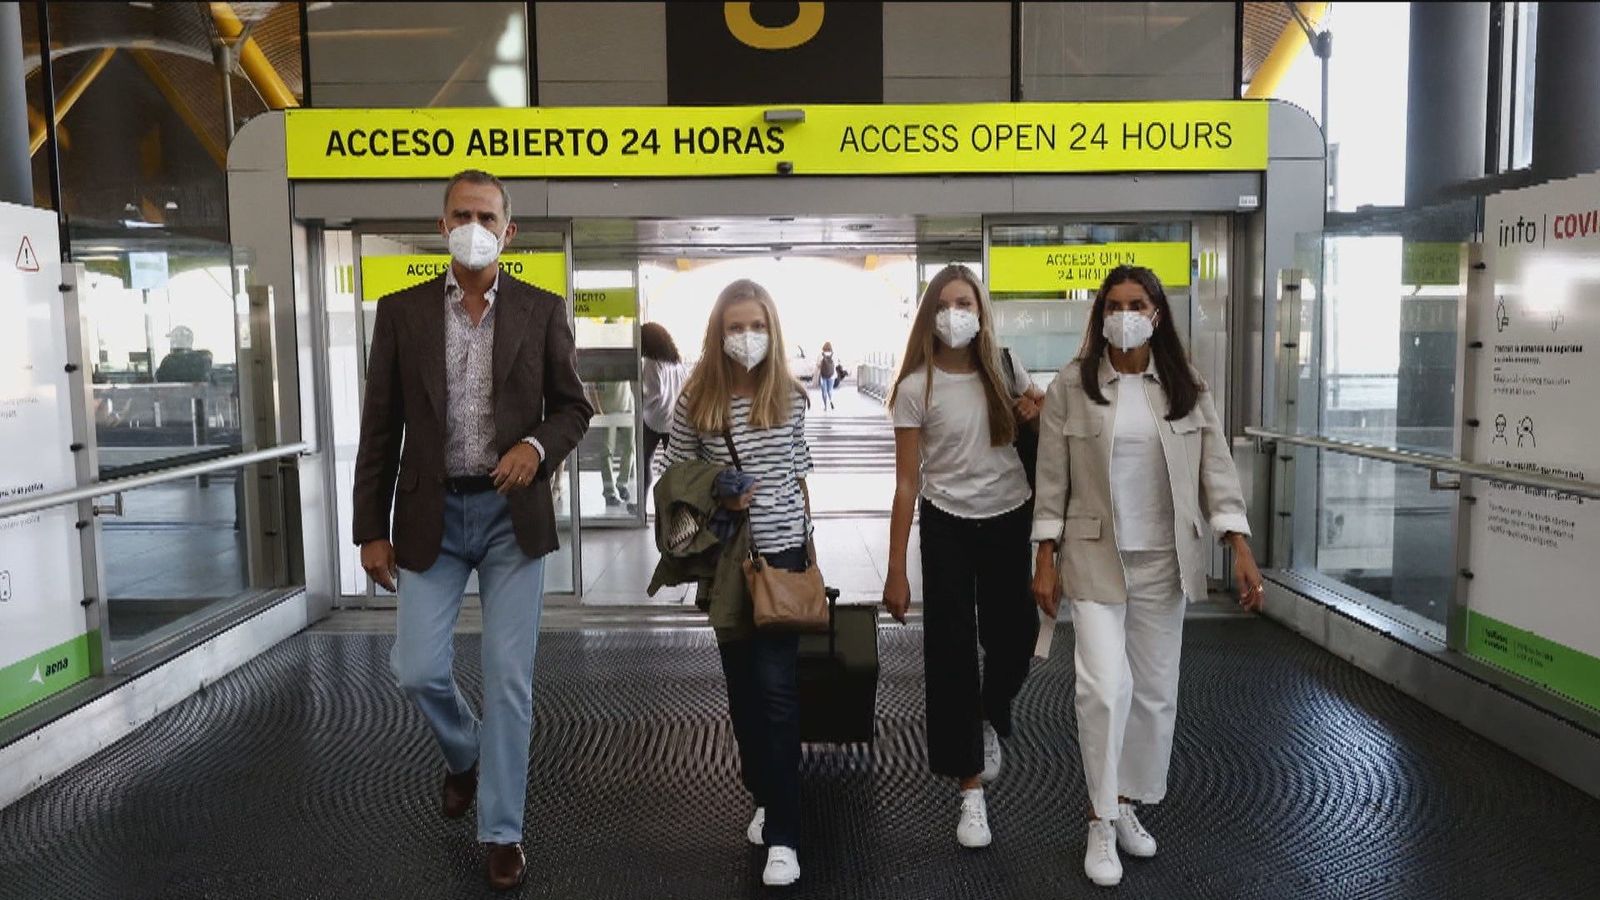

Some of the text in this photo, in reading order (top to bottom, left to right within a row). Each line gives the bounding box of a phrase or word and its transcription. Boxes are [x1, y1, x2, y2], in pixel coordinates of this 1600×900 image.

[326, 126, 784, 157] ACCESO ABIERTO 24 HORAS
[840, 121, 1232, 153] ACCESS OPEN 24 HOURS
[1499, 216, 1536, 247] info
[1554, 210, 1600, 240] COVI
[406, 262, 450, 276] ACCES
[1046, 251, 1135, 266] ACCESS OPEN
